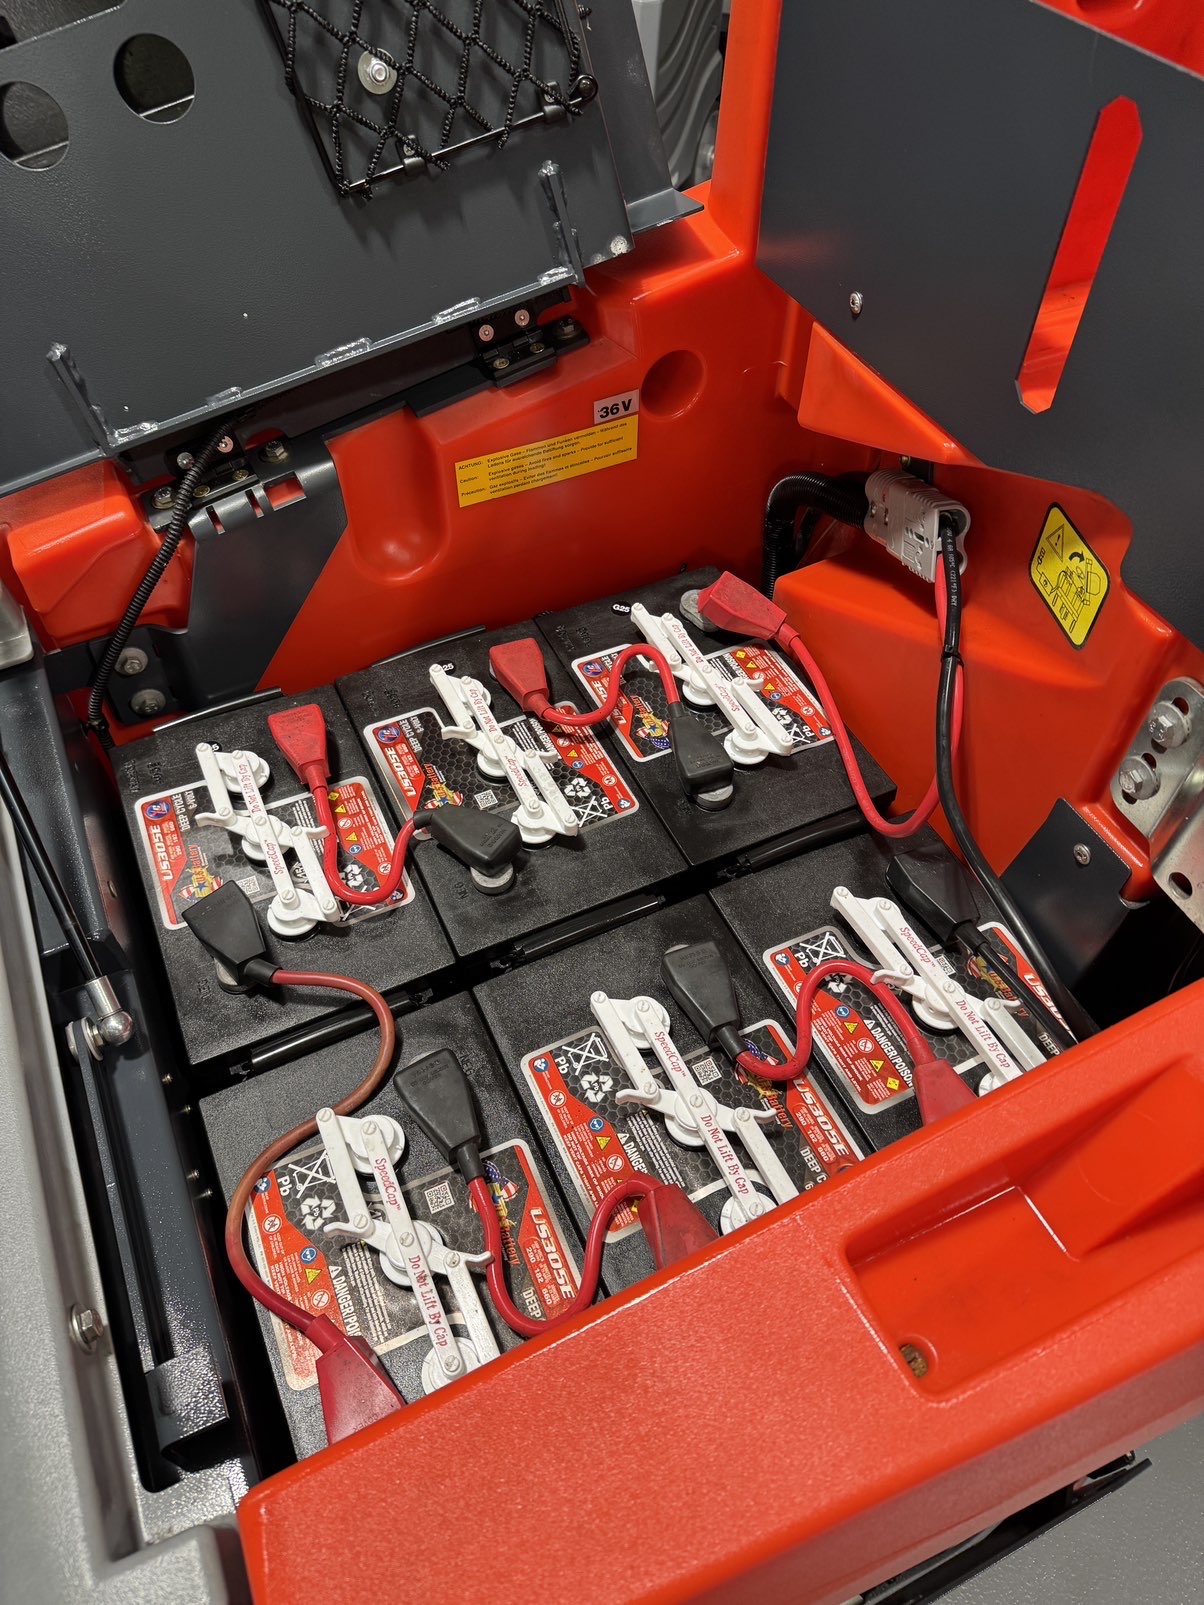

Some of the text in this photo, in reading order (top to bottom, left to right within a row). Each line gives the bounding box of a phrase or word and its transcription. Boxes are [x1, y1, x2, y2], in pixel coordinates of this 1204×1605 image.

[599, 398, 632, 419] 36 V
[458, 460, 483, 470] ACHTUNG:
[443, 662, 454, 672] 25
[399, 719, 422, 752] DEEP CYCLE
[801, 724, 815, 738] Pb
[423, 762, 441, 787] Battery
[172, 793, 191, 831] DEEP CYCLE
[184, 790, 198, 809] 6-VOLT
[600, 796, 613, 810] Pb
[187, 843, 202, 871] Battery
[794, 950, 810, 969] Pb
[955, 997, 1012, 1071] Do Not Lift By Cap
[555, 1056, 570, 1075] Pb
[795, 1112, 808, 1126] 290
[806, 1129, 818, 1143] 182
[700, 1113, 752, 1197] Do Not Lift By Cap
[800, 1147, 822, 1175] DEEP
[275, 1175, 293, 1197] Pb
[525, 1246, 537, 1264] 290
[533, 1267, 544, 1284] 182
[408, 1255, 452, 1349] Do Not Lift By Cap
[522, 1288, 543, 1320] DEEP
